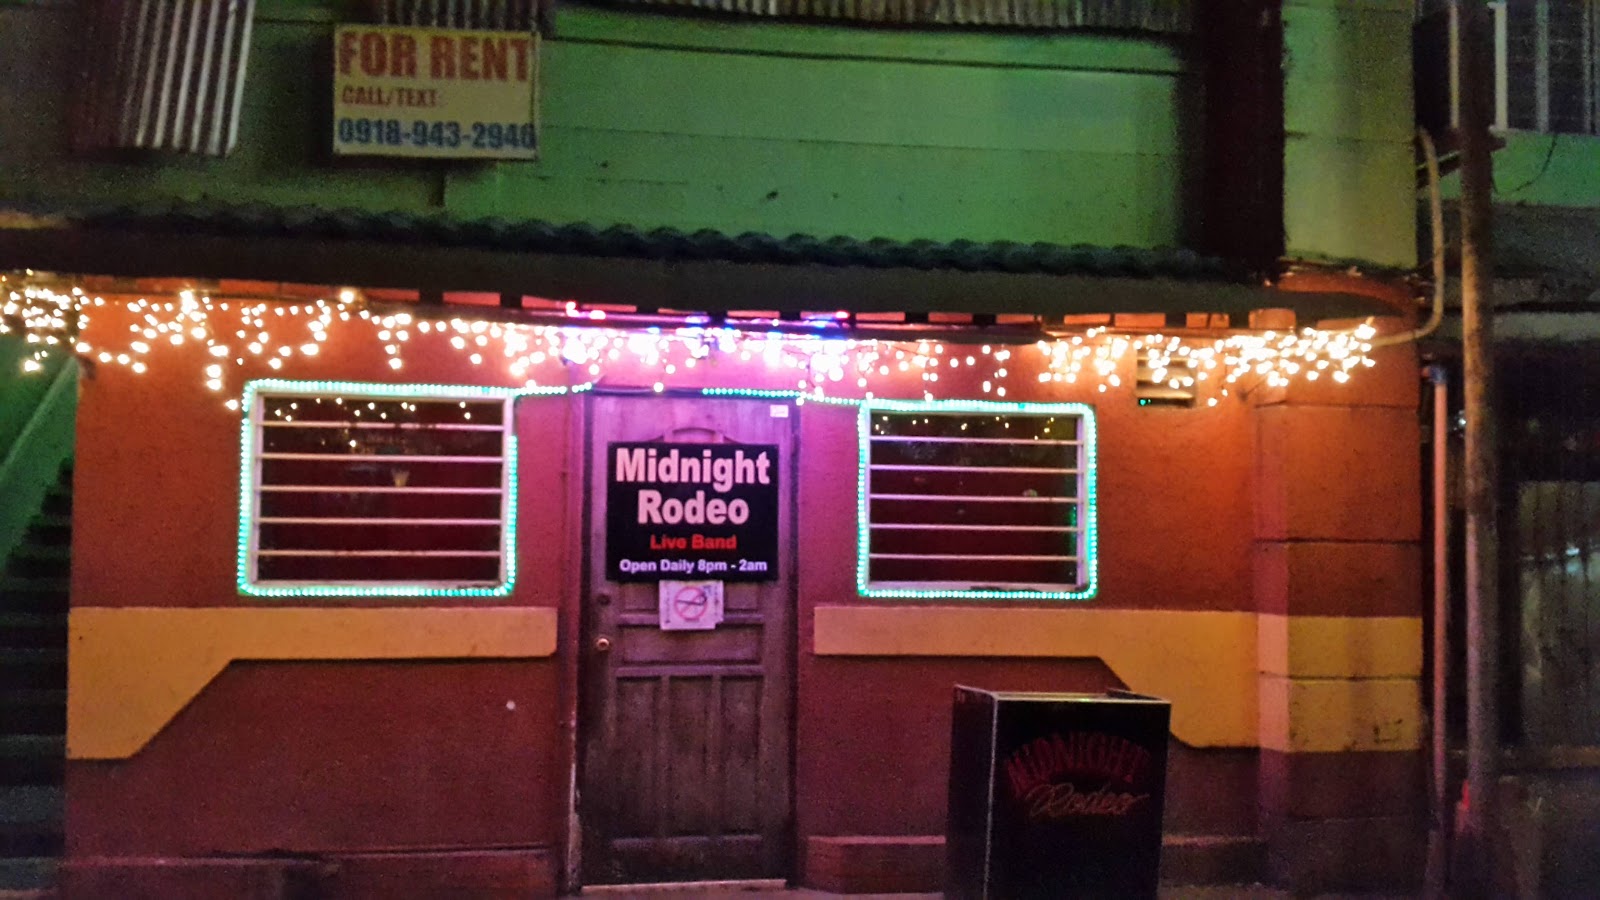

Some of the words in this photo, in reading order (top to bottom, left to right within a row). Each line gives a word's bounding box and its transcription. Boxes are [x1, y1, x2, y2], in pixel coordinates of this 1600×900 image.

[338, 32, 417, 77] FOR
[430, 36, 529, 81] RENT
[616, 447, 770, 492] Midnight
[637, 489, 749, 525] Rodeo
[650, 535, 686, 549] Live
[692, 535, 737, 549] Band
[619, 560, 657, 573] Open
[660, 560, 694, 574] Daily
[697, 560, 727, 573] 8pm
[738, 560, 768, 571] 2am
